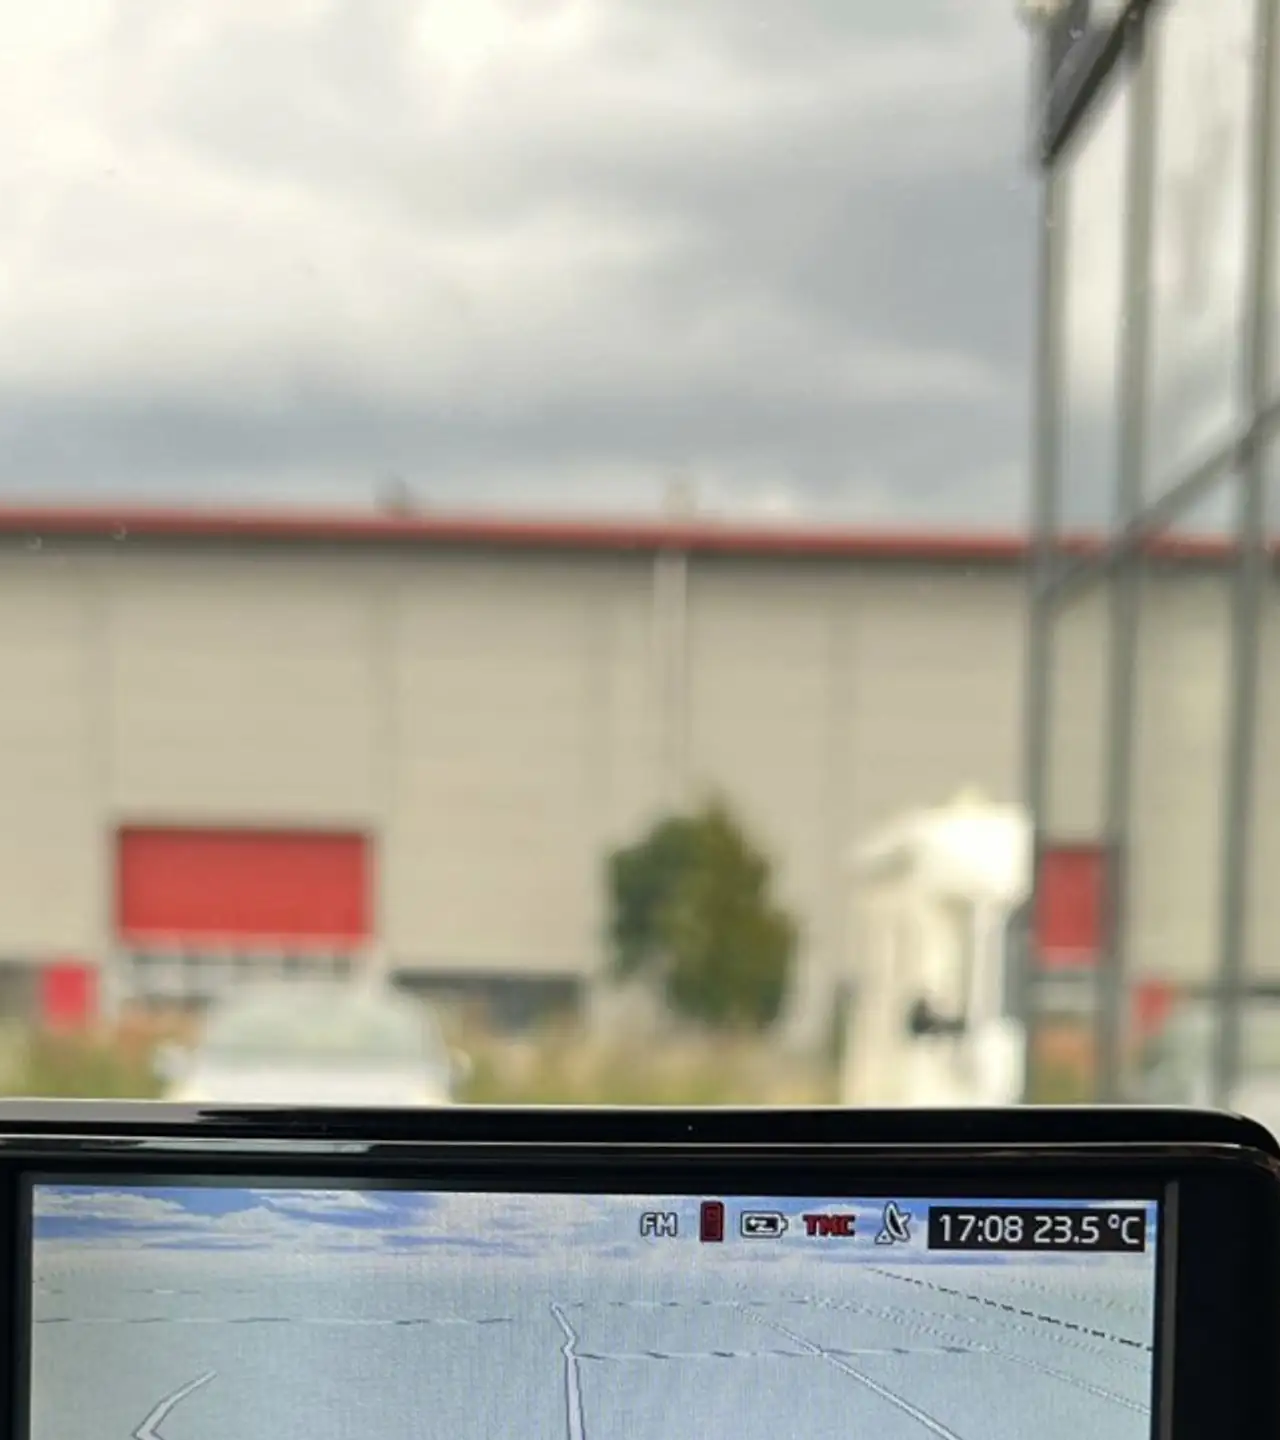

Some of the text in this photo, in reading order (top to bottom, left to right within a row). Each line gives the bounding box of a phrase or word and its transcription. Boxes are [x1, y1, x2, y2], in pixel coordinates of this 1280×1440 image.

[639, 1211, 678, 1237] FM
[802, 1214, 856, 1237] TMC
[938, 1213, 1024, 1243] 17:08
[1033, 1215, 1100, 1244] 23.5
